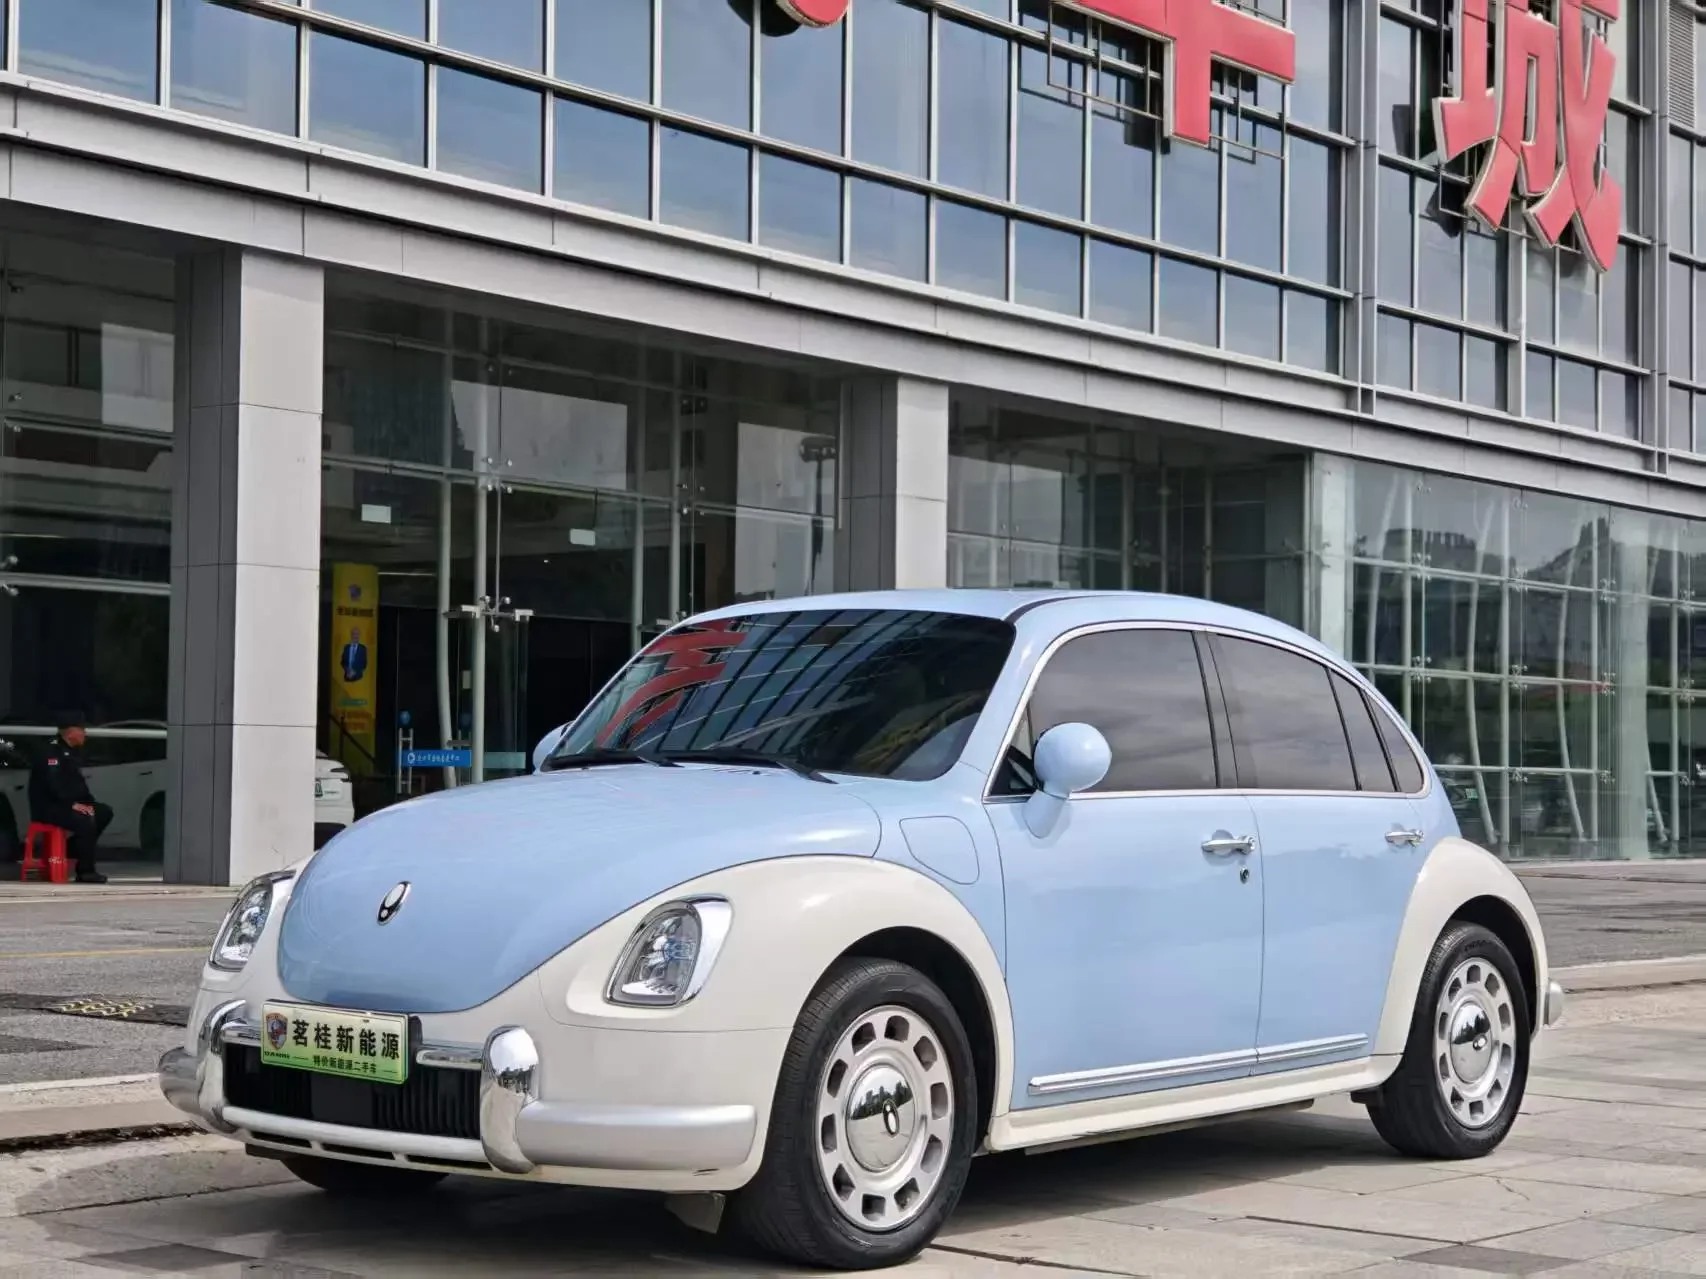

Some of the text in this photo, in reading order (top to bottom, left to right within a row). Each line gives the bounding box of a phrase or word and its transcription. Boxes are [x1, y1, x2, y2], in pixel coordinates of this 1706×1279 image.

[292, 1019, 400, 1059] 茗桂新能源
